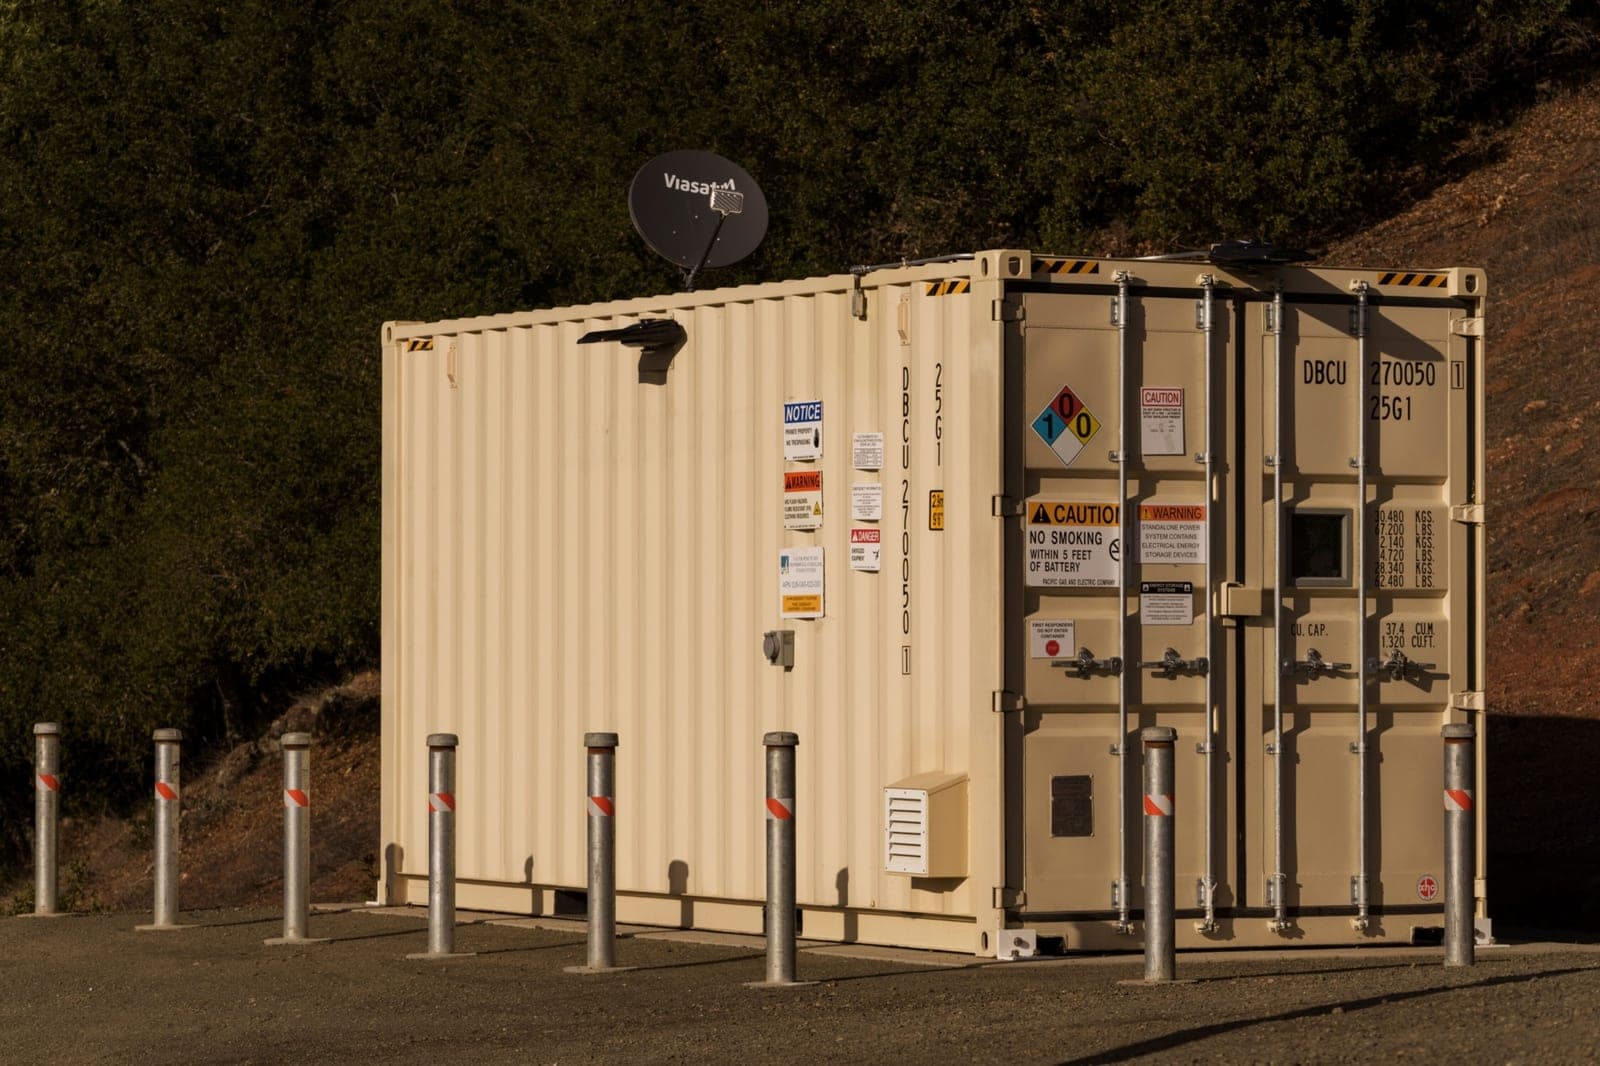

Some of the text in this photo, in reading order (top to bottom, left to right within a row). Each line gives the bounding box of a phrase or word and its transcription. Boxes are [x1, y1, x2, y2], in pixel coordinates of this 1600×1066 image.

[1303, 360, 1347, 385] DBCU
[1370, 361, 1436, 386] 270050
[1144, 391, 1180, 404] CAUTION
[786, 403, 821, 422] NOTICE
[1058, 392, 1074, 419] 0
[1370, 395, 1412, 421] 25G1
[1042, 414, 1053, 439] 1
[1076, 412, 1091, 438] 0
[791, 474, 820, 489] WARNING
[1152, 507, 1202, 520] WARNING
[859, 531, 879, 541] DANGER
[1029, 530, 1103, 545] NO SMOKING
[902, 479, 910, 635] 270050
[1029, 549, 1092, 560] WITHIN 5 FEET
[1029, 561, 1080, 572] OF BATTERY
[1308, 623, 1329, 636] CAP.
[1386, 622, 1405, 635] 37.4
